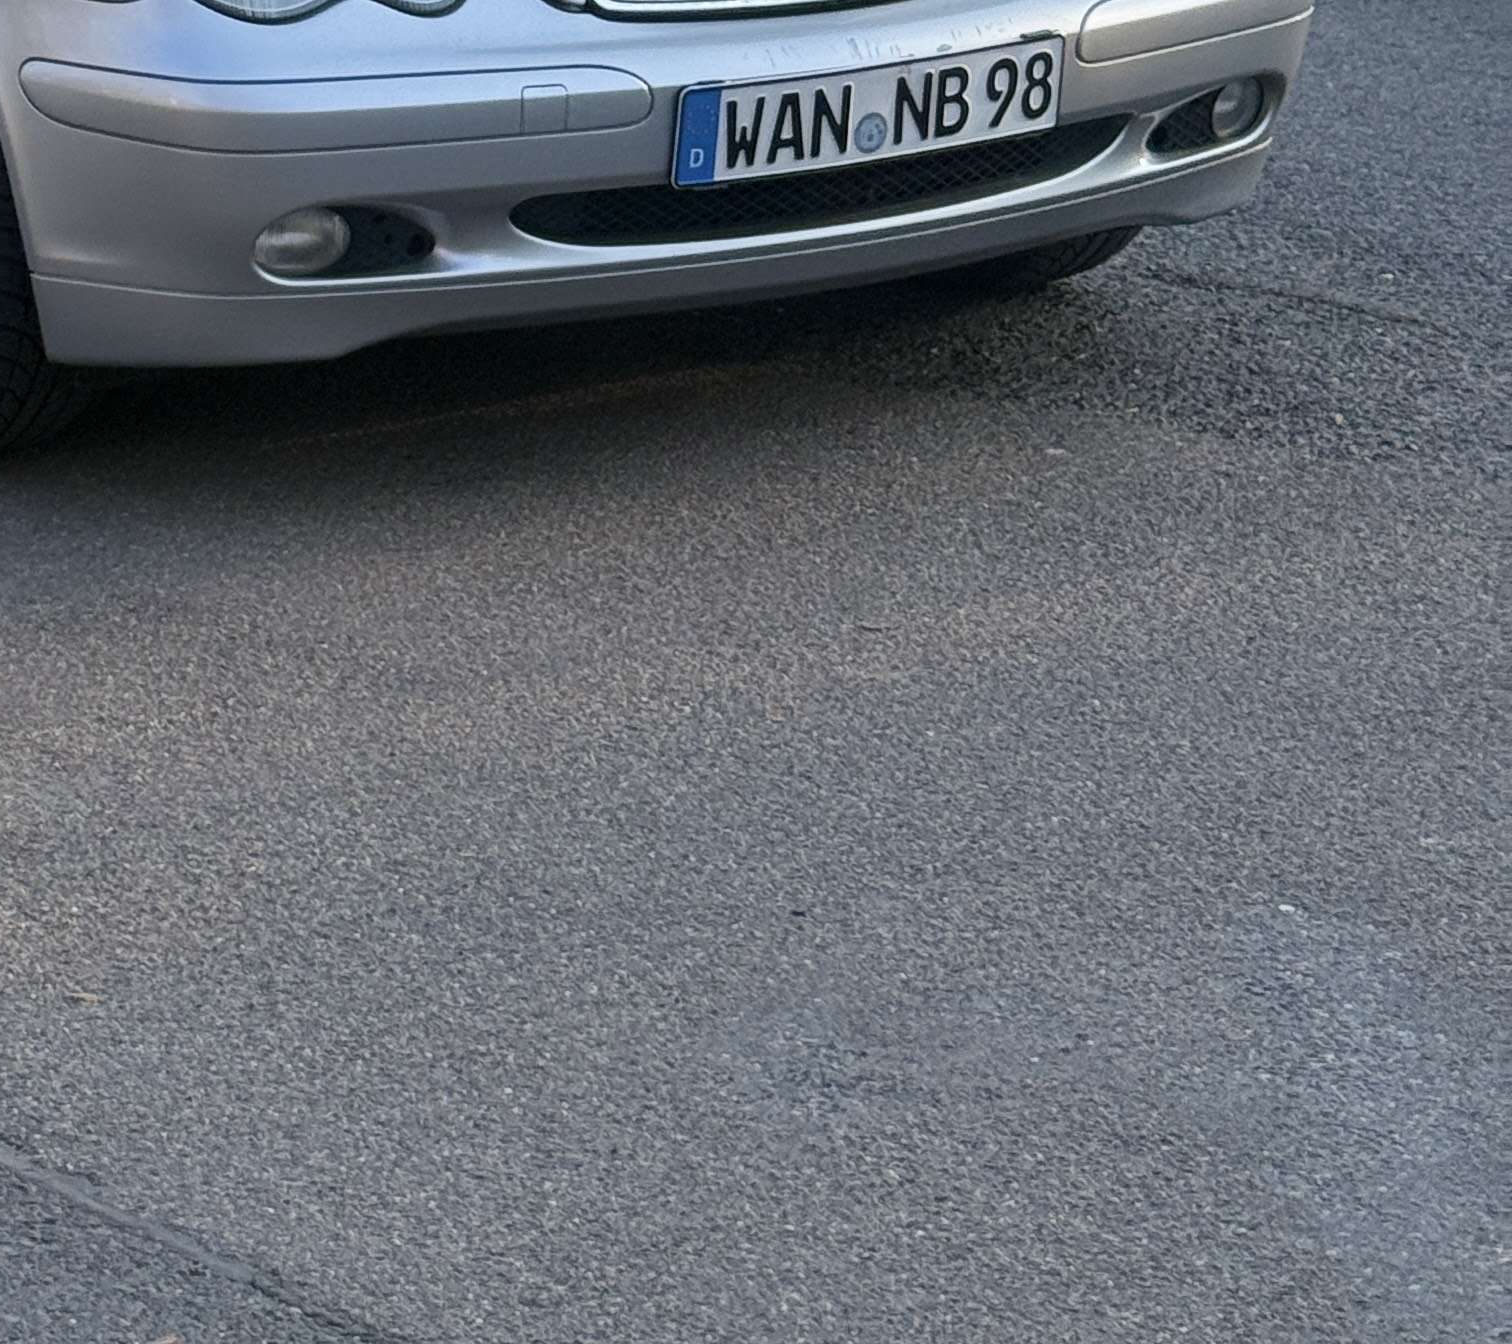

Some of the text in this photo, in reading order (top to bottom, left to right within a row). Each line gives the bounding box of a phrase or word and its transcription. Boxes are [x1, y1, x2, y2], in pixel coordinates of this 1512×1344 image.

[726, 52, 1053, 169] WAN NB 98
[690, 148, 705, 168] D
